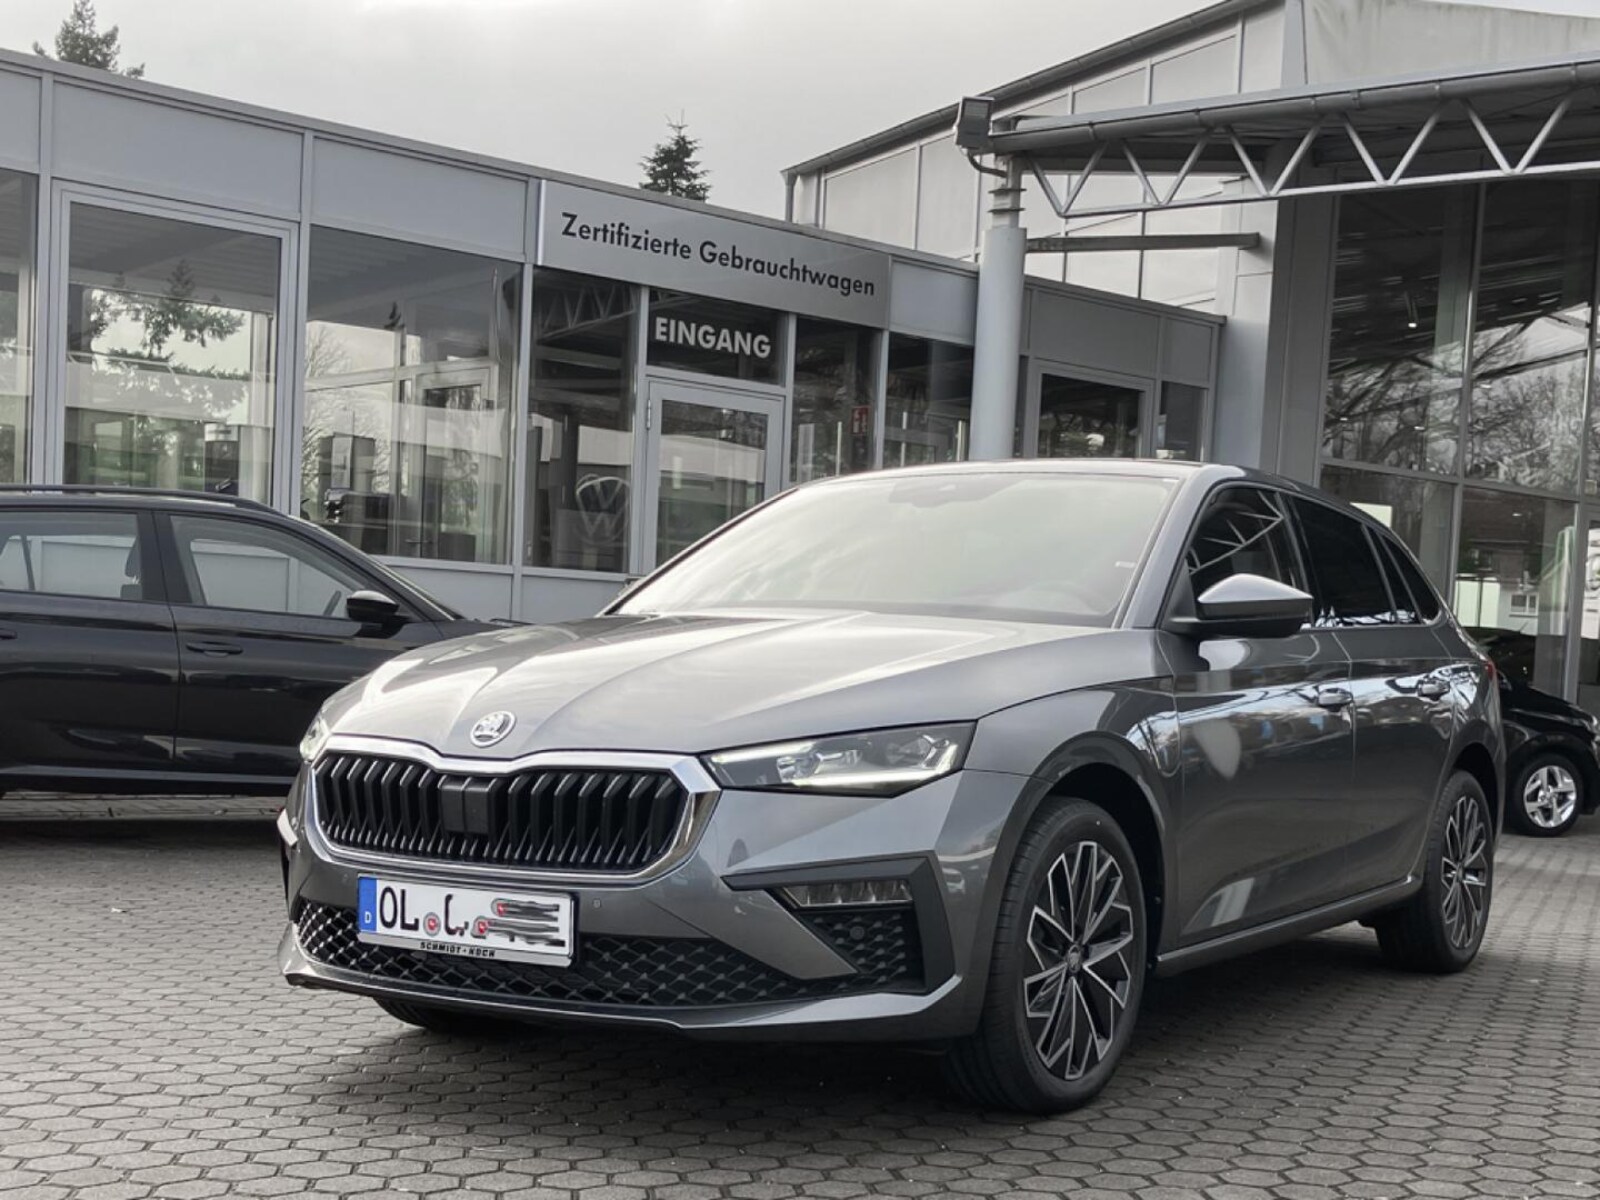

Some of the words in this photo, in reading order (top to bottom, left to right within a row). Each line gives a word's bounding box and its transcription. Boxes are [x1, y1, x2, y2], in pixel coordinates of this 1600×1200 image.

[561, 212, 692, 260] Zertifizierte
[699, 241, 875, 297] Gebrauchtwagen
[655, 317, 771, 359] EINGANG
[380, 886, 419, 932] OL
